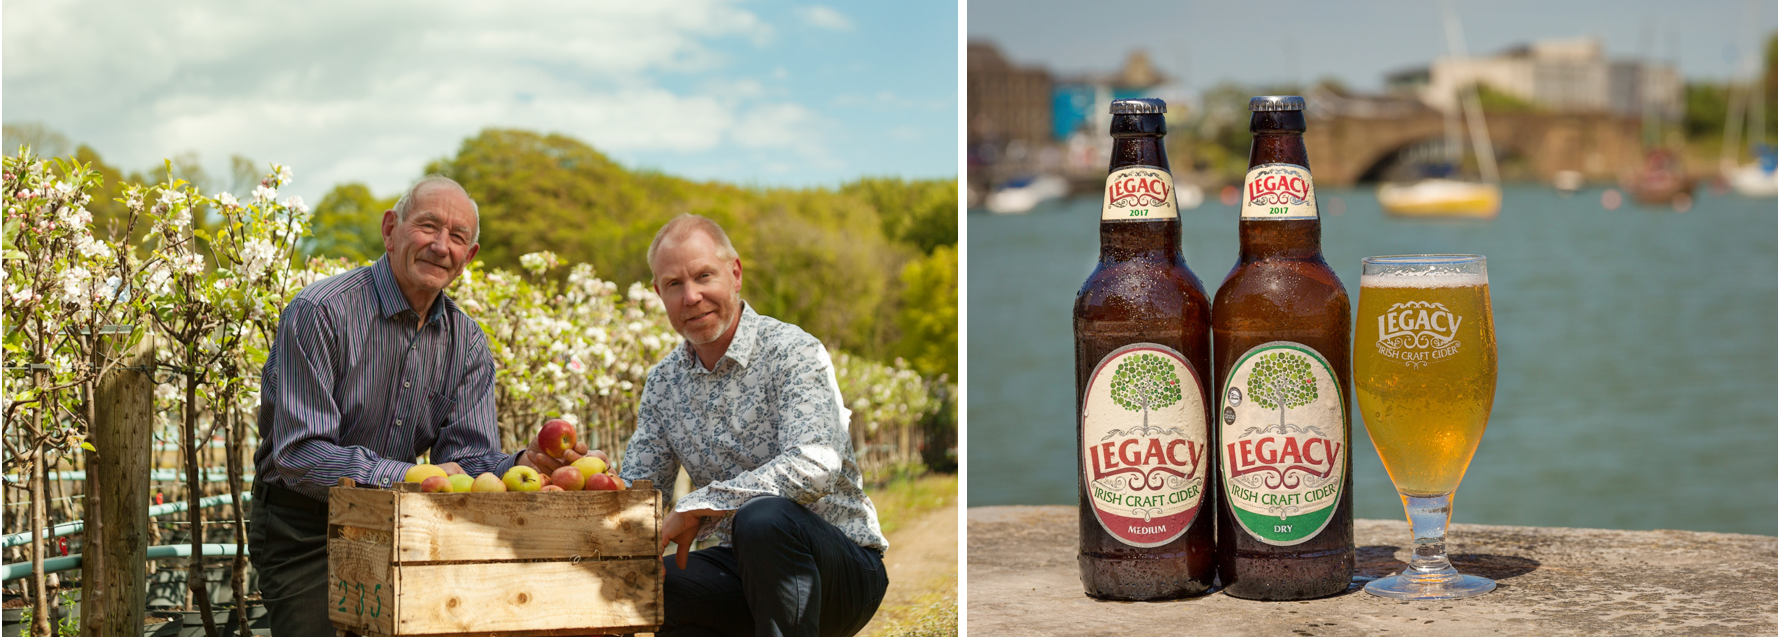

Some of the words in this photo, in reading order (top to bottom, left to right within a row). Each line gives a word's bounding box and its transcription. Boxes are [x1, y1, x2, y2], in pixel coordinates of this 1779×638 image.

[1108, 178, 1171, 205] LEGACY
[1248, 175, 1310, 202] LEGACY
[1129, 209, 1149, 217] 2017
[1269, 206, 1289, 215] 2017
[1377, 309, 1463, 342] LEGACY
[1378, 345, 1400, 359] IRISH
[1401, 351, 1430, 361] CRAFT
[1431, 345, 1459, 359] CIDER
[1089, 438, 1204, 481] LEGACY
[1226, 436, 1341, 479] LEGACY
[1094, 486, 1122, 505] IRISH
[1125, 494, 1165, 507] CRAFT
[1168, 484, 1200, 505] CIDER
[1231, 483, 1258, 503] IRISH
[1261, 493, 1301, 506] CRAFT
[1304, 483, 1336, 503] CIDER
[1128, 524, 1167, 535] MEDIUM
[1274, 524, 1293, 533] DRY
